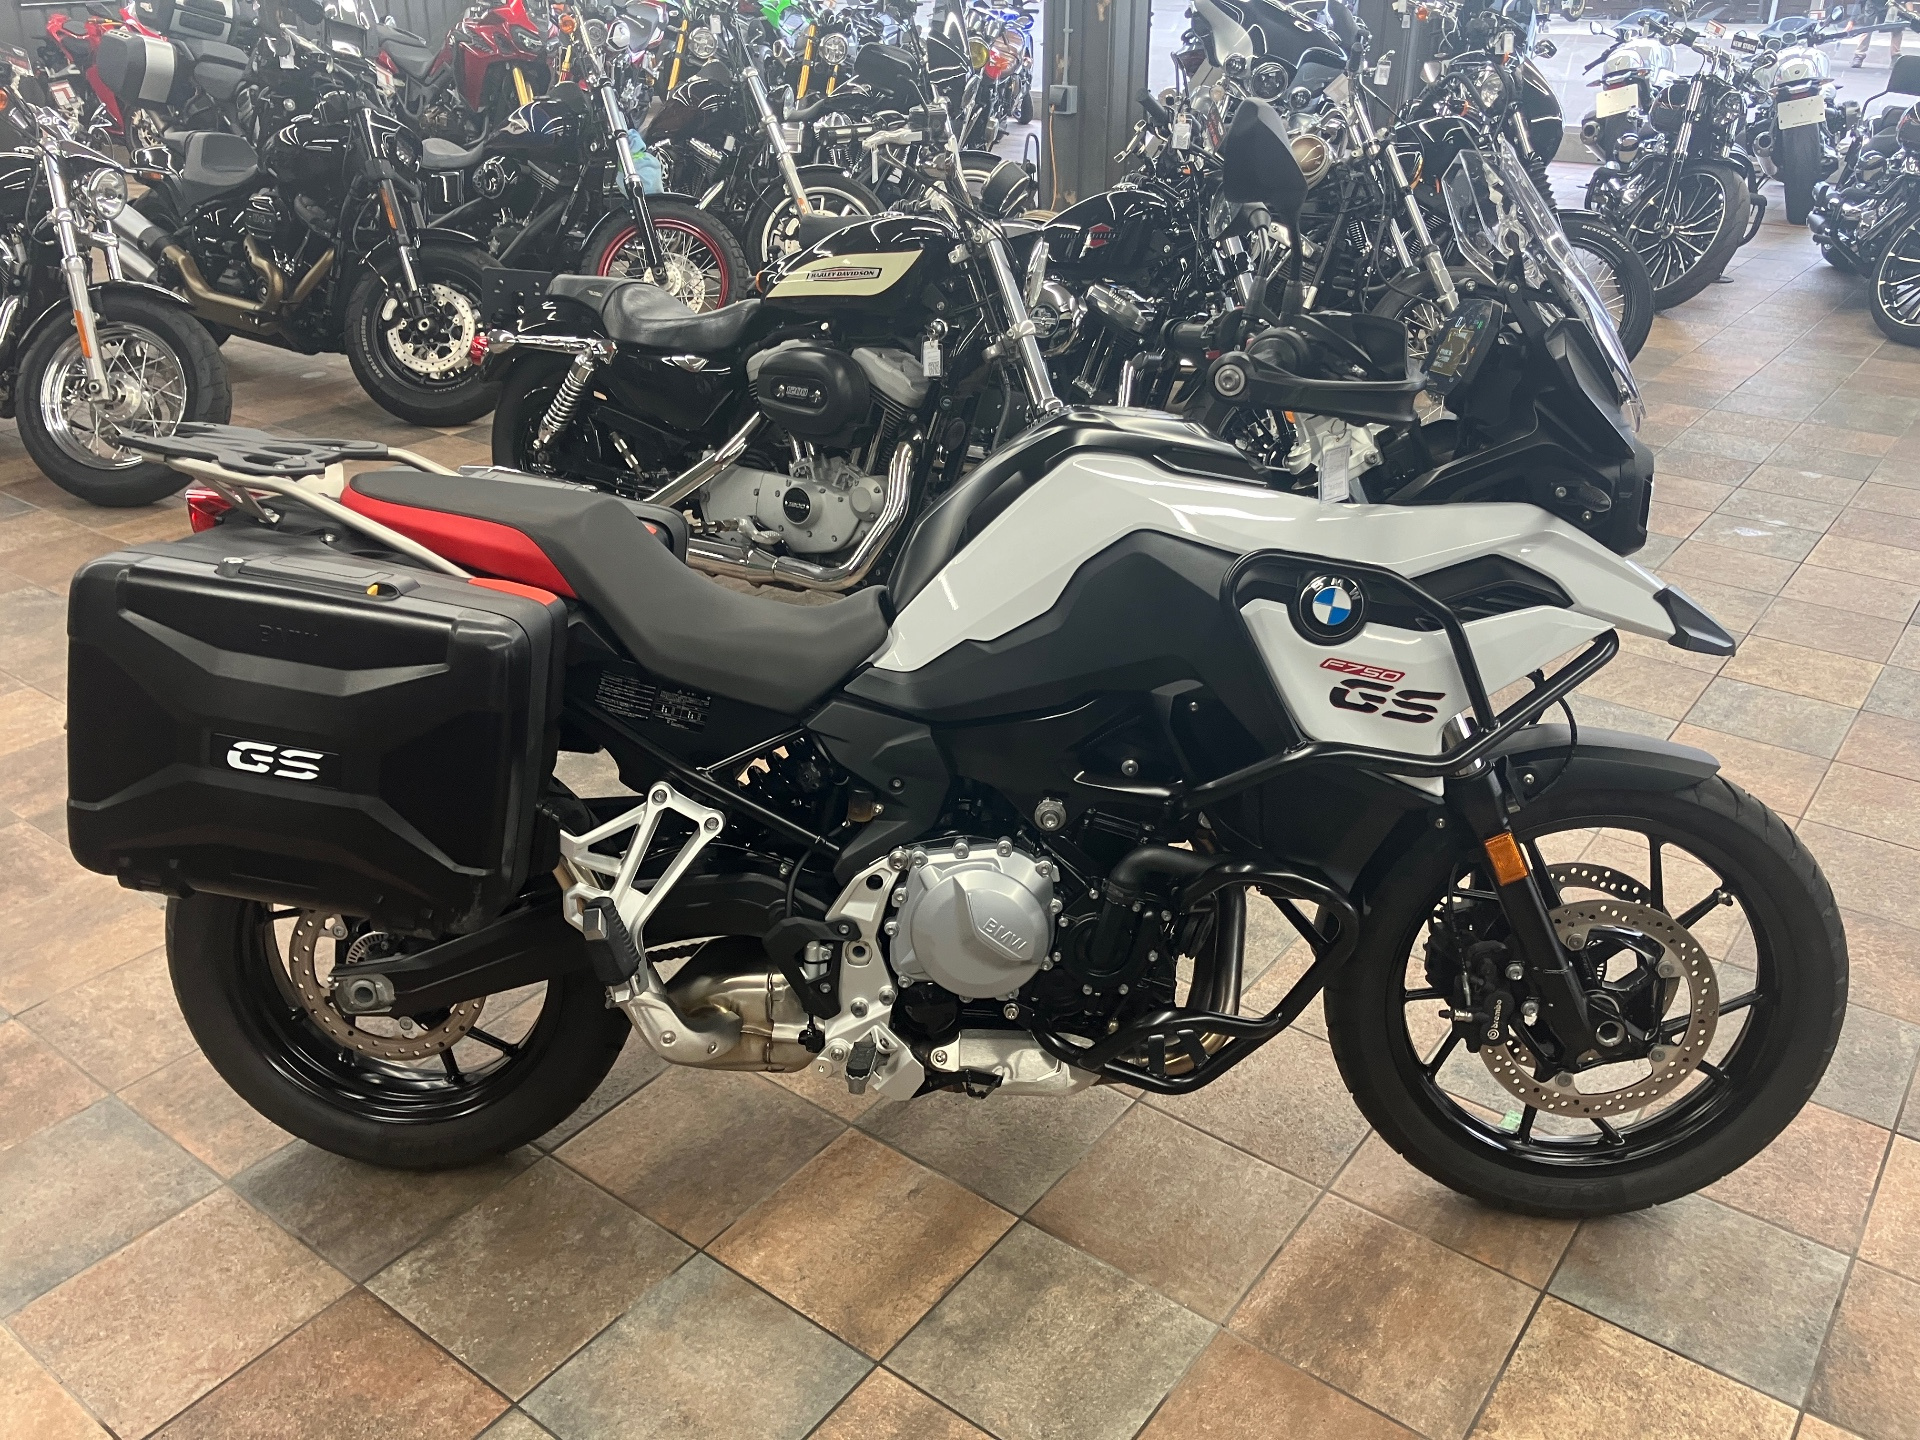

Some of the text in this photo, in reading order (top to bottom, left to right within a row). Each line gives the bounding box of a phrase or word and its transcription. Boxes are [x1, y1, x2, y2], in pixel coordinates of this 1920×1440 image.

[1581, 224, 1611, 237] DUNLOP
[1310, 576, 1361, 600] BMW
[1322, 659, 1402, 682] F750
[1329, 678, 1446, 724] GS
[226, 740, 325, 780] GS
[982, 916, 1027, 951] BMW
[1491, 999, 1503, 1029] brembo
